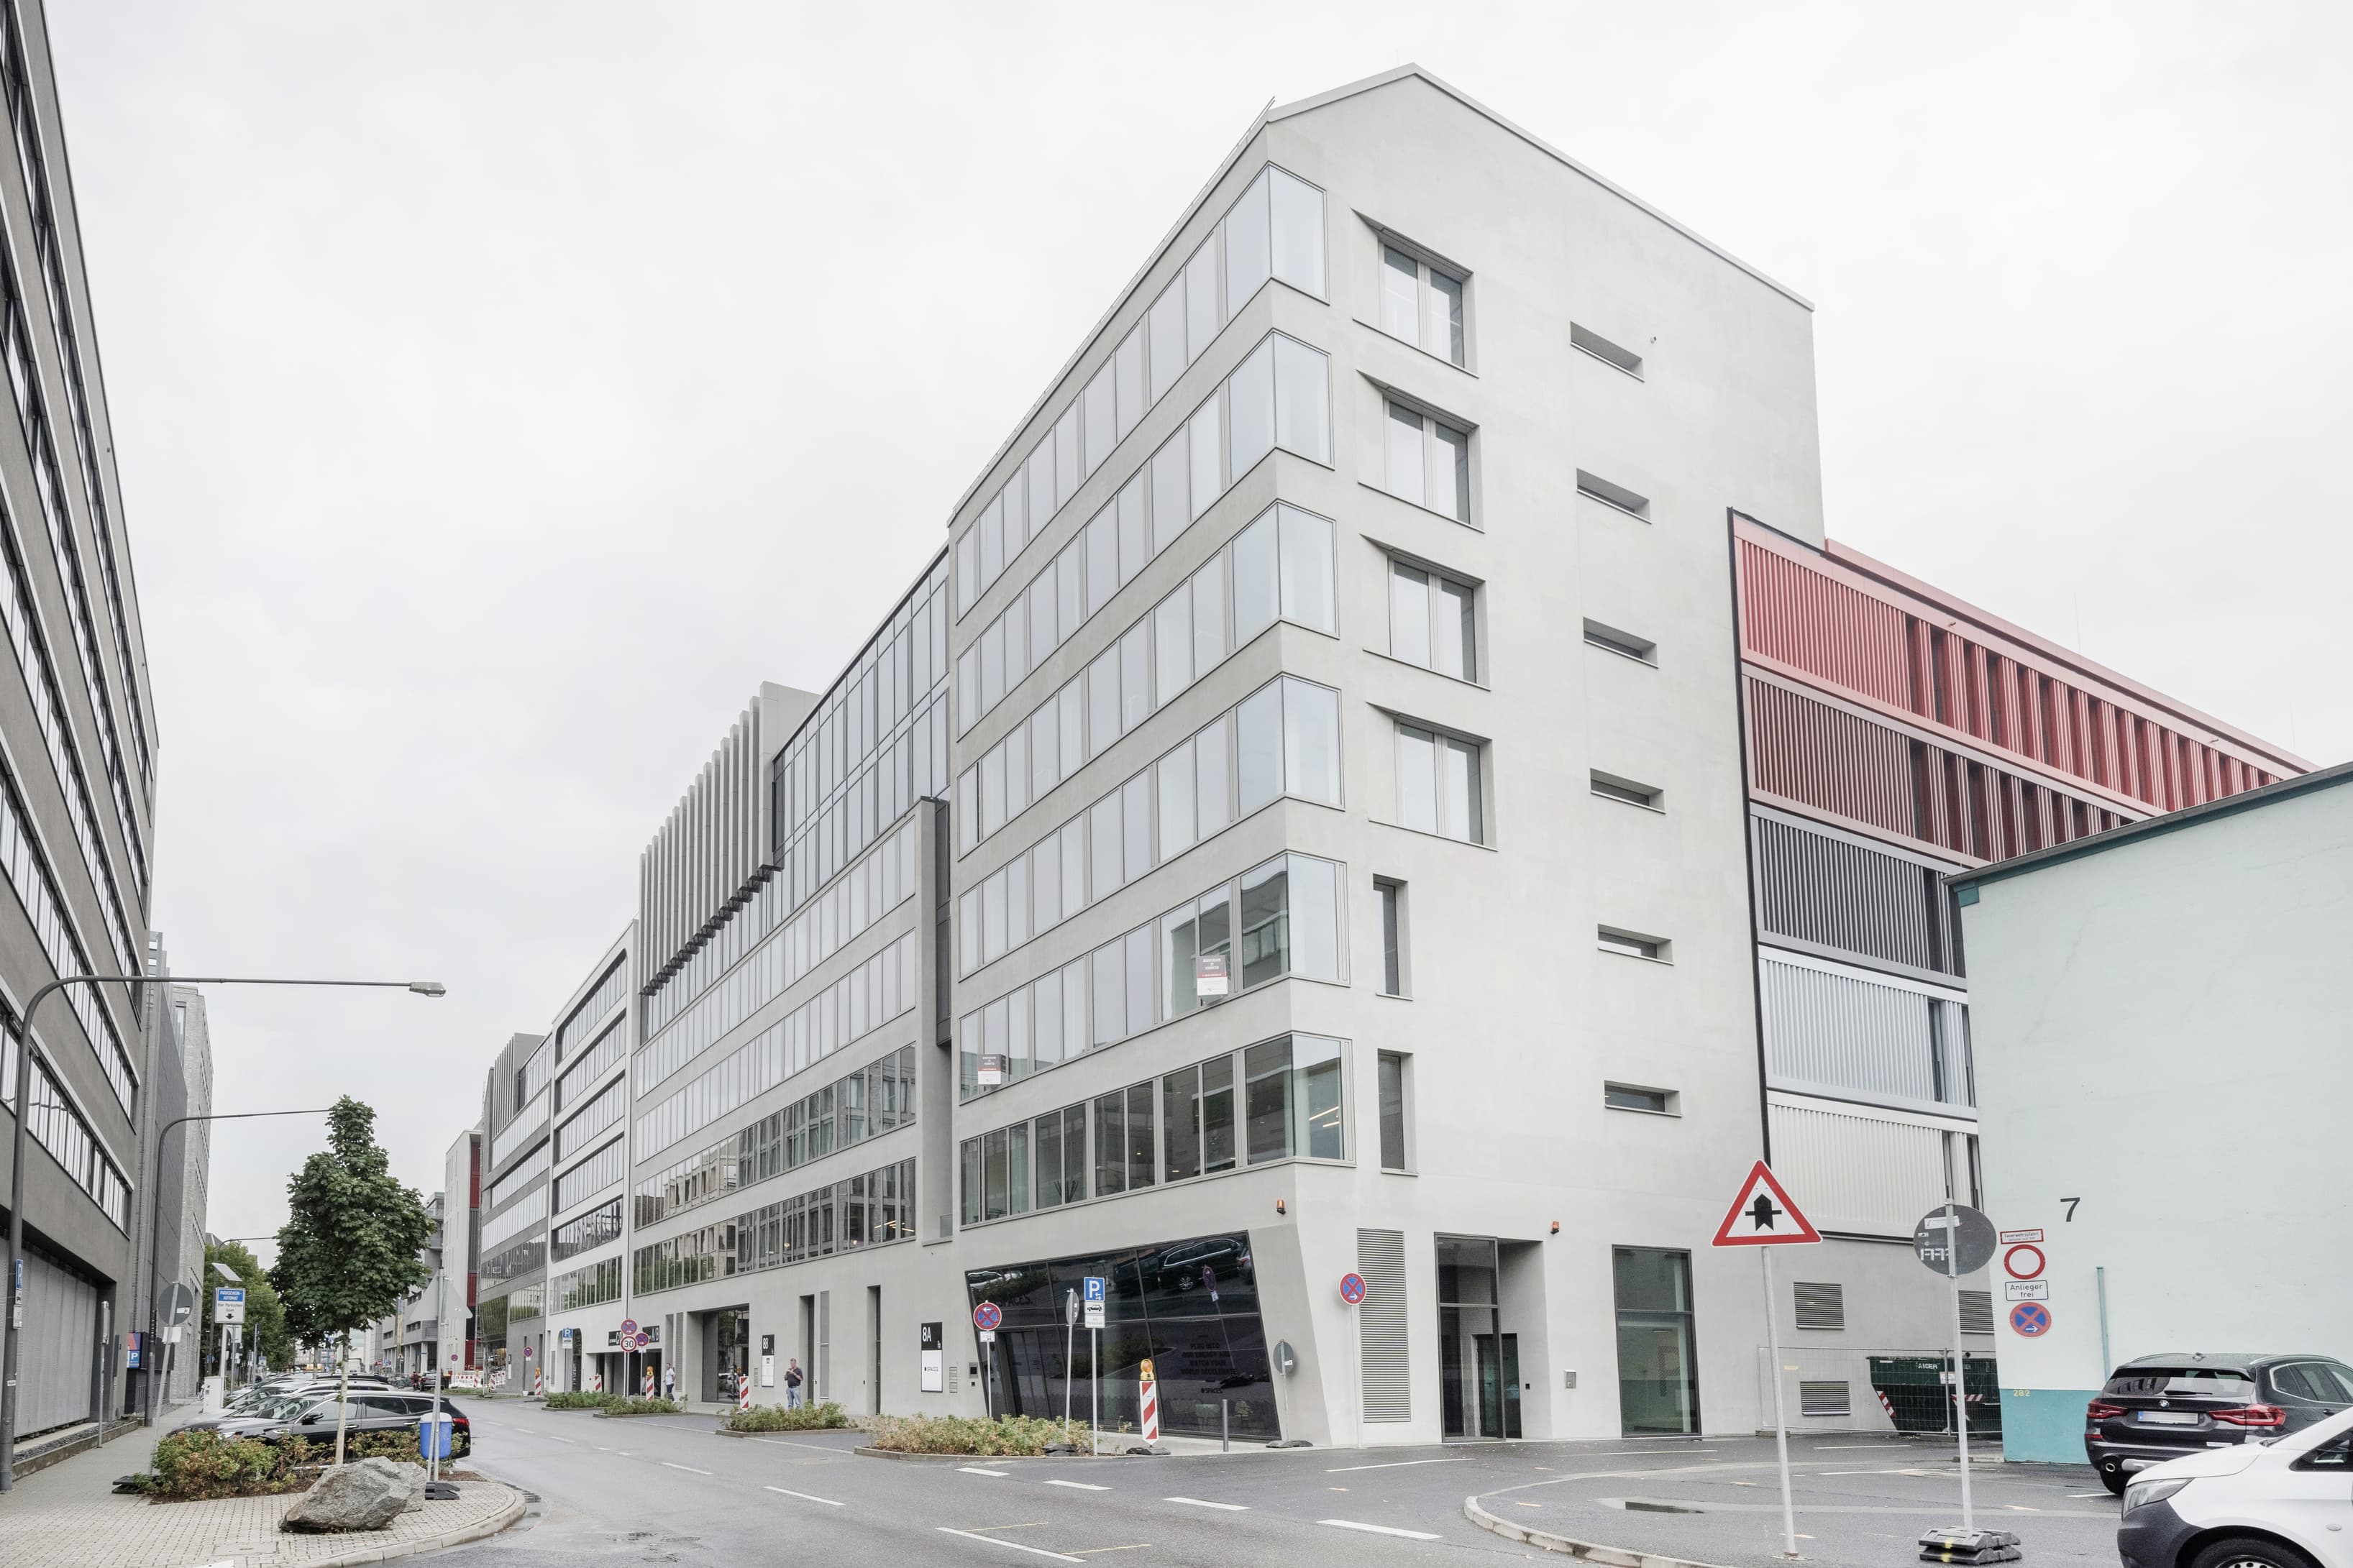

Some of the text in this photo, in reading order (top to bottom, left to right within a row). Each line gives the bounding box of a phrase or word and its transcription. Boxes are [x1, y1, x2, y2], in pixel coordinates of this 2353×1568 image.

[2060, 1197, 2080, 1222] 7
[1089, 1280, 1100, 1298] P
[2010, 1283, 2043, 1292] Anlieger
[922, 1326, 932, 1342] 8A
